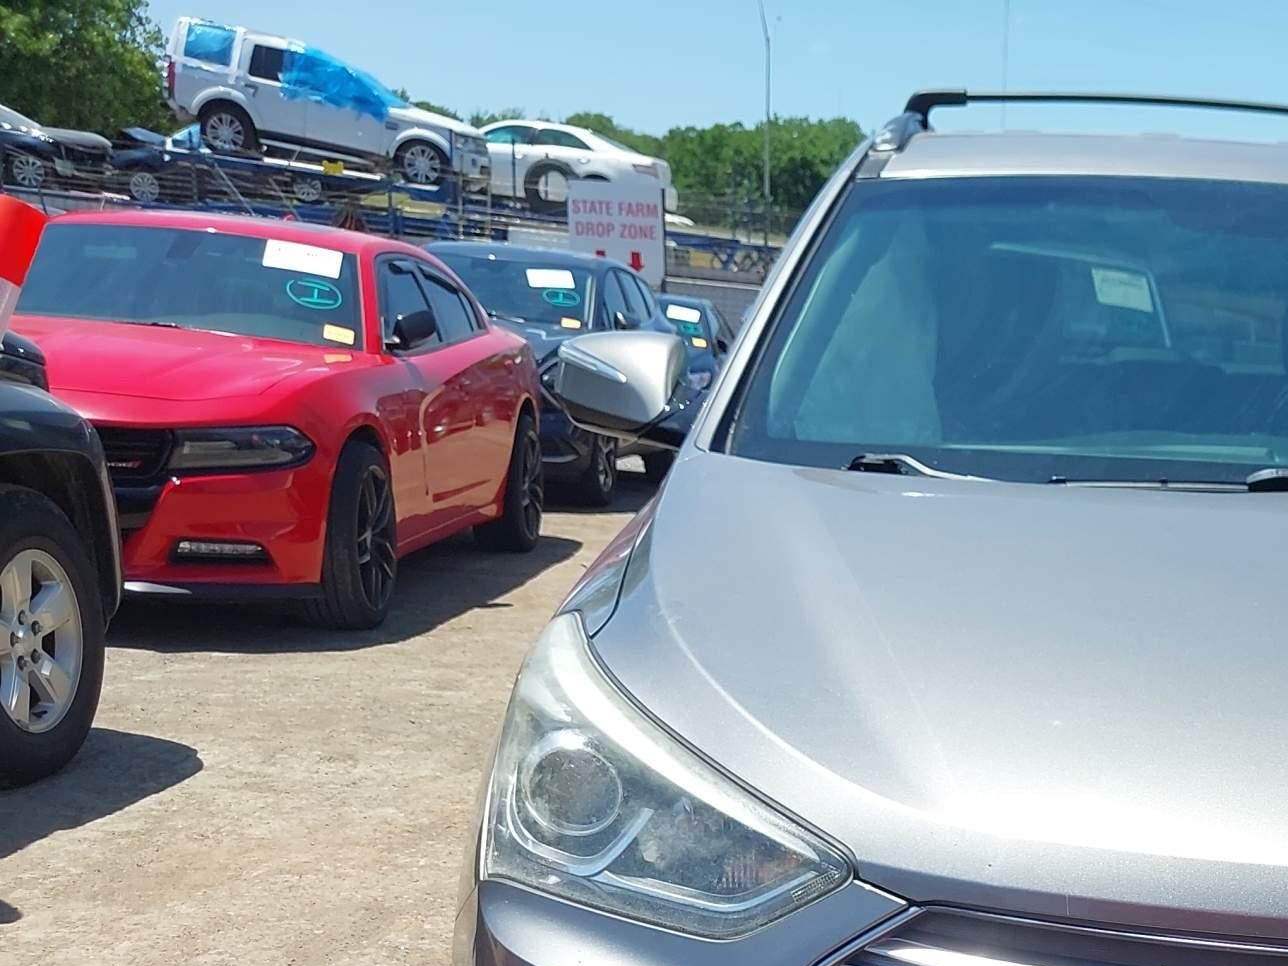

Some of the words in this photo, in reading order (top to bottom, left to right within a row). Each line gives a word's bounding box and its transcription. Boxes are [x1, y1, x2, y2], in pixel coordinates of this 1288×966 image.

[572, 199, 613, 216] STATE
[618, 201, 658, 218] FARM
[575, 221, 615, 238] DROP
[620, 223, 657, 240] ZONE
